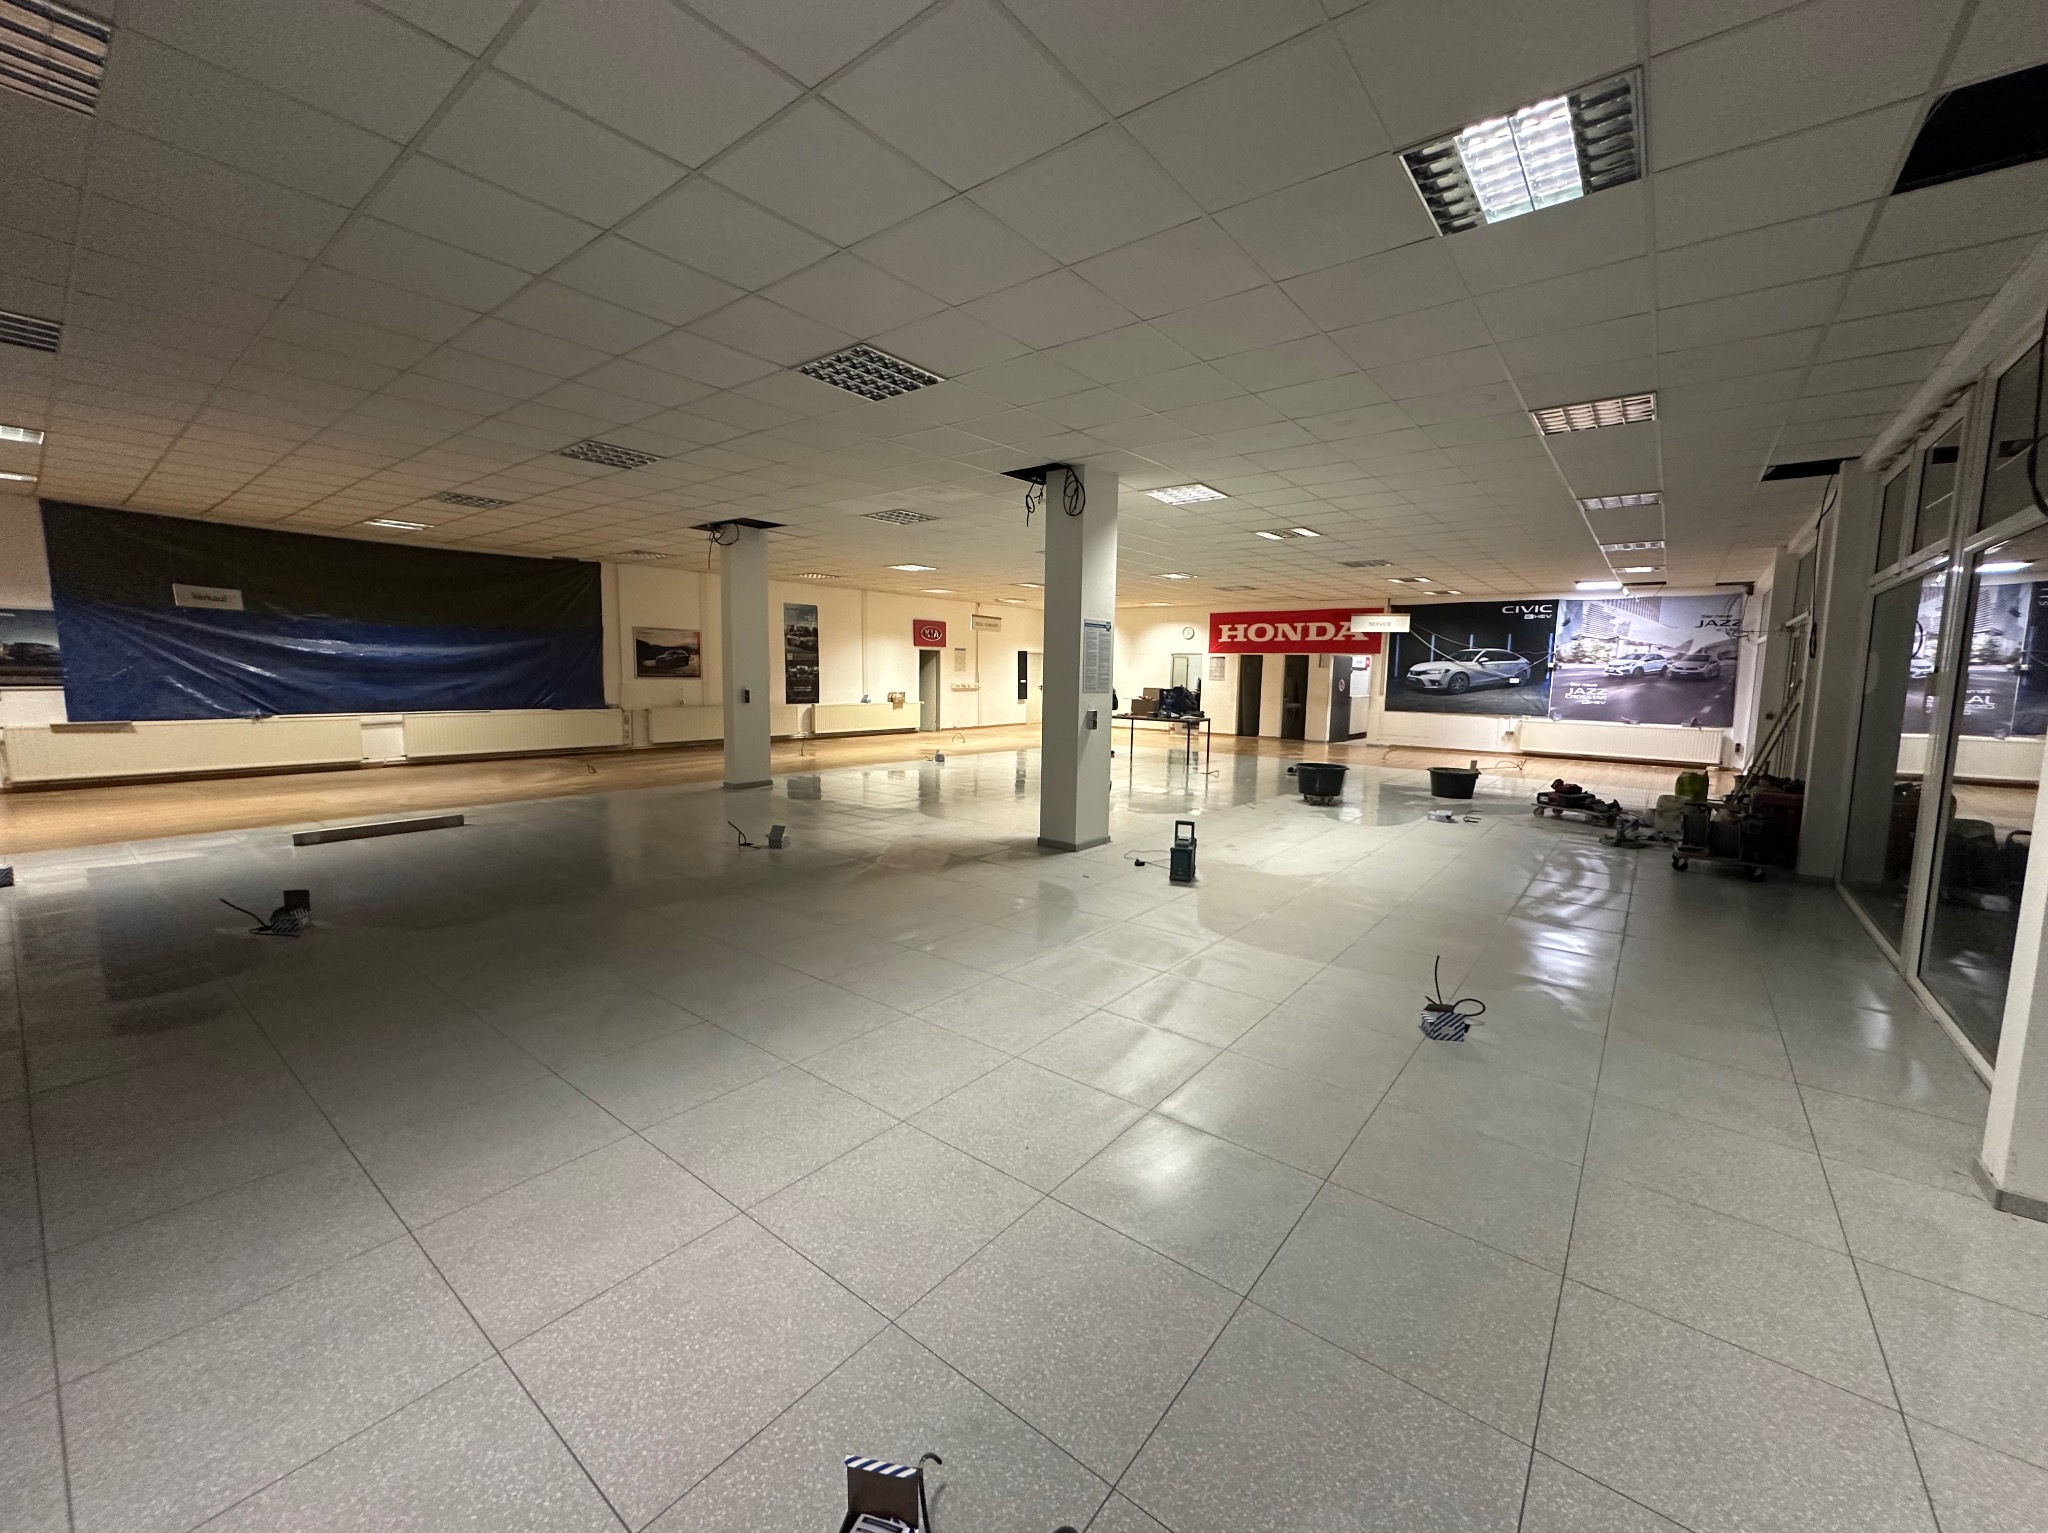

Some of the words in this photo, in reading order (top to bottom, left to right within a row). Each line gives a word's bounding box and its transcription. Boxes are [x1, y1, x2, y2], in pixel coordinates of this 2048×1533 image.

[1501, 604, 1553, 614] CIVIC
[1695, 619, 1742, 629] JAZZ
[924, 628, 940, 639] KIA
[1566, 687, 1608, 696] JAZZ
